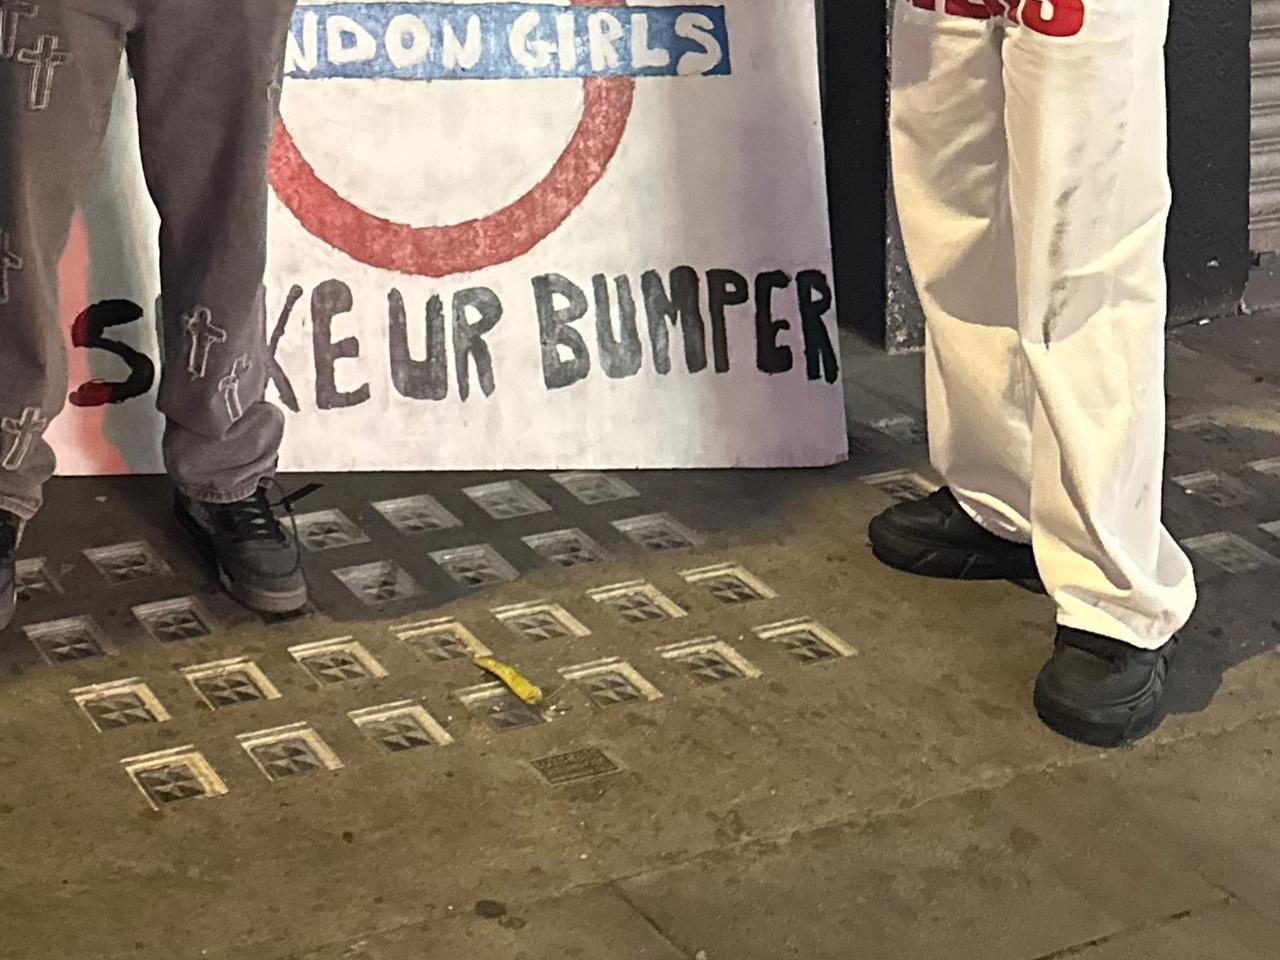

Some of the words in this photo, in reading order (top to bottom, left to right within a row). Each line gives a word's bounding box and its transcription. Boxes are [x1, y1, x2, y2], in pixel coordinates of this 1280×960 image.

[283, 10, 482, 73] NDON
[508, 11, 723, 77] GIRLS
[69, 279, 370, 413] SKE
[387, 286, 504, 402] UR
[531, 265, 840, 390] BUMPER
